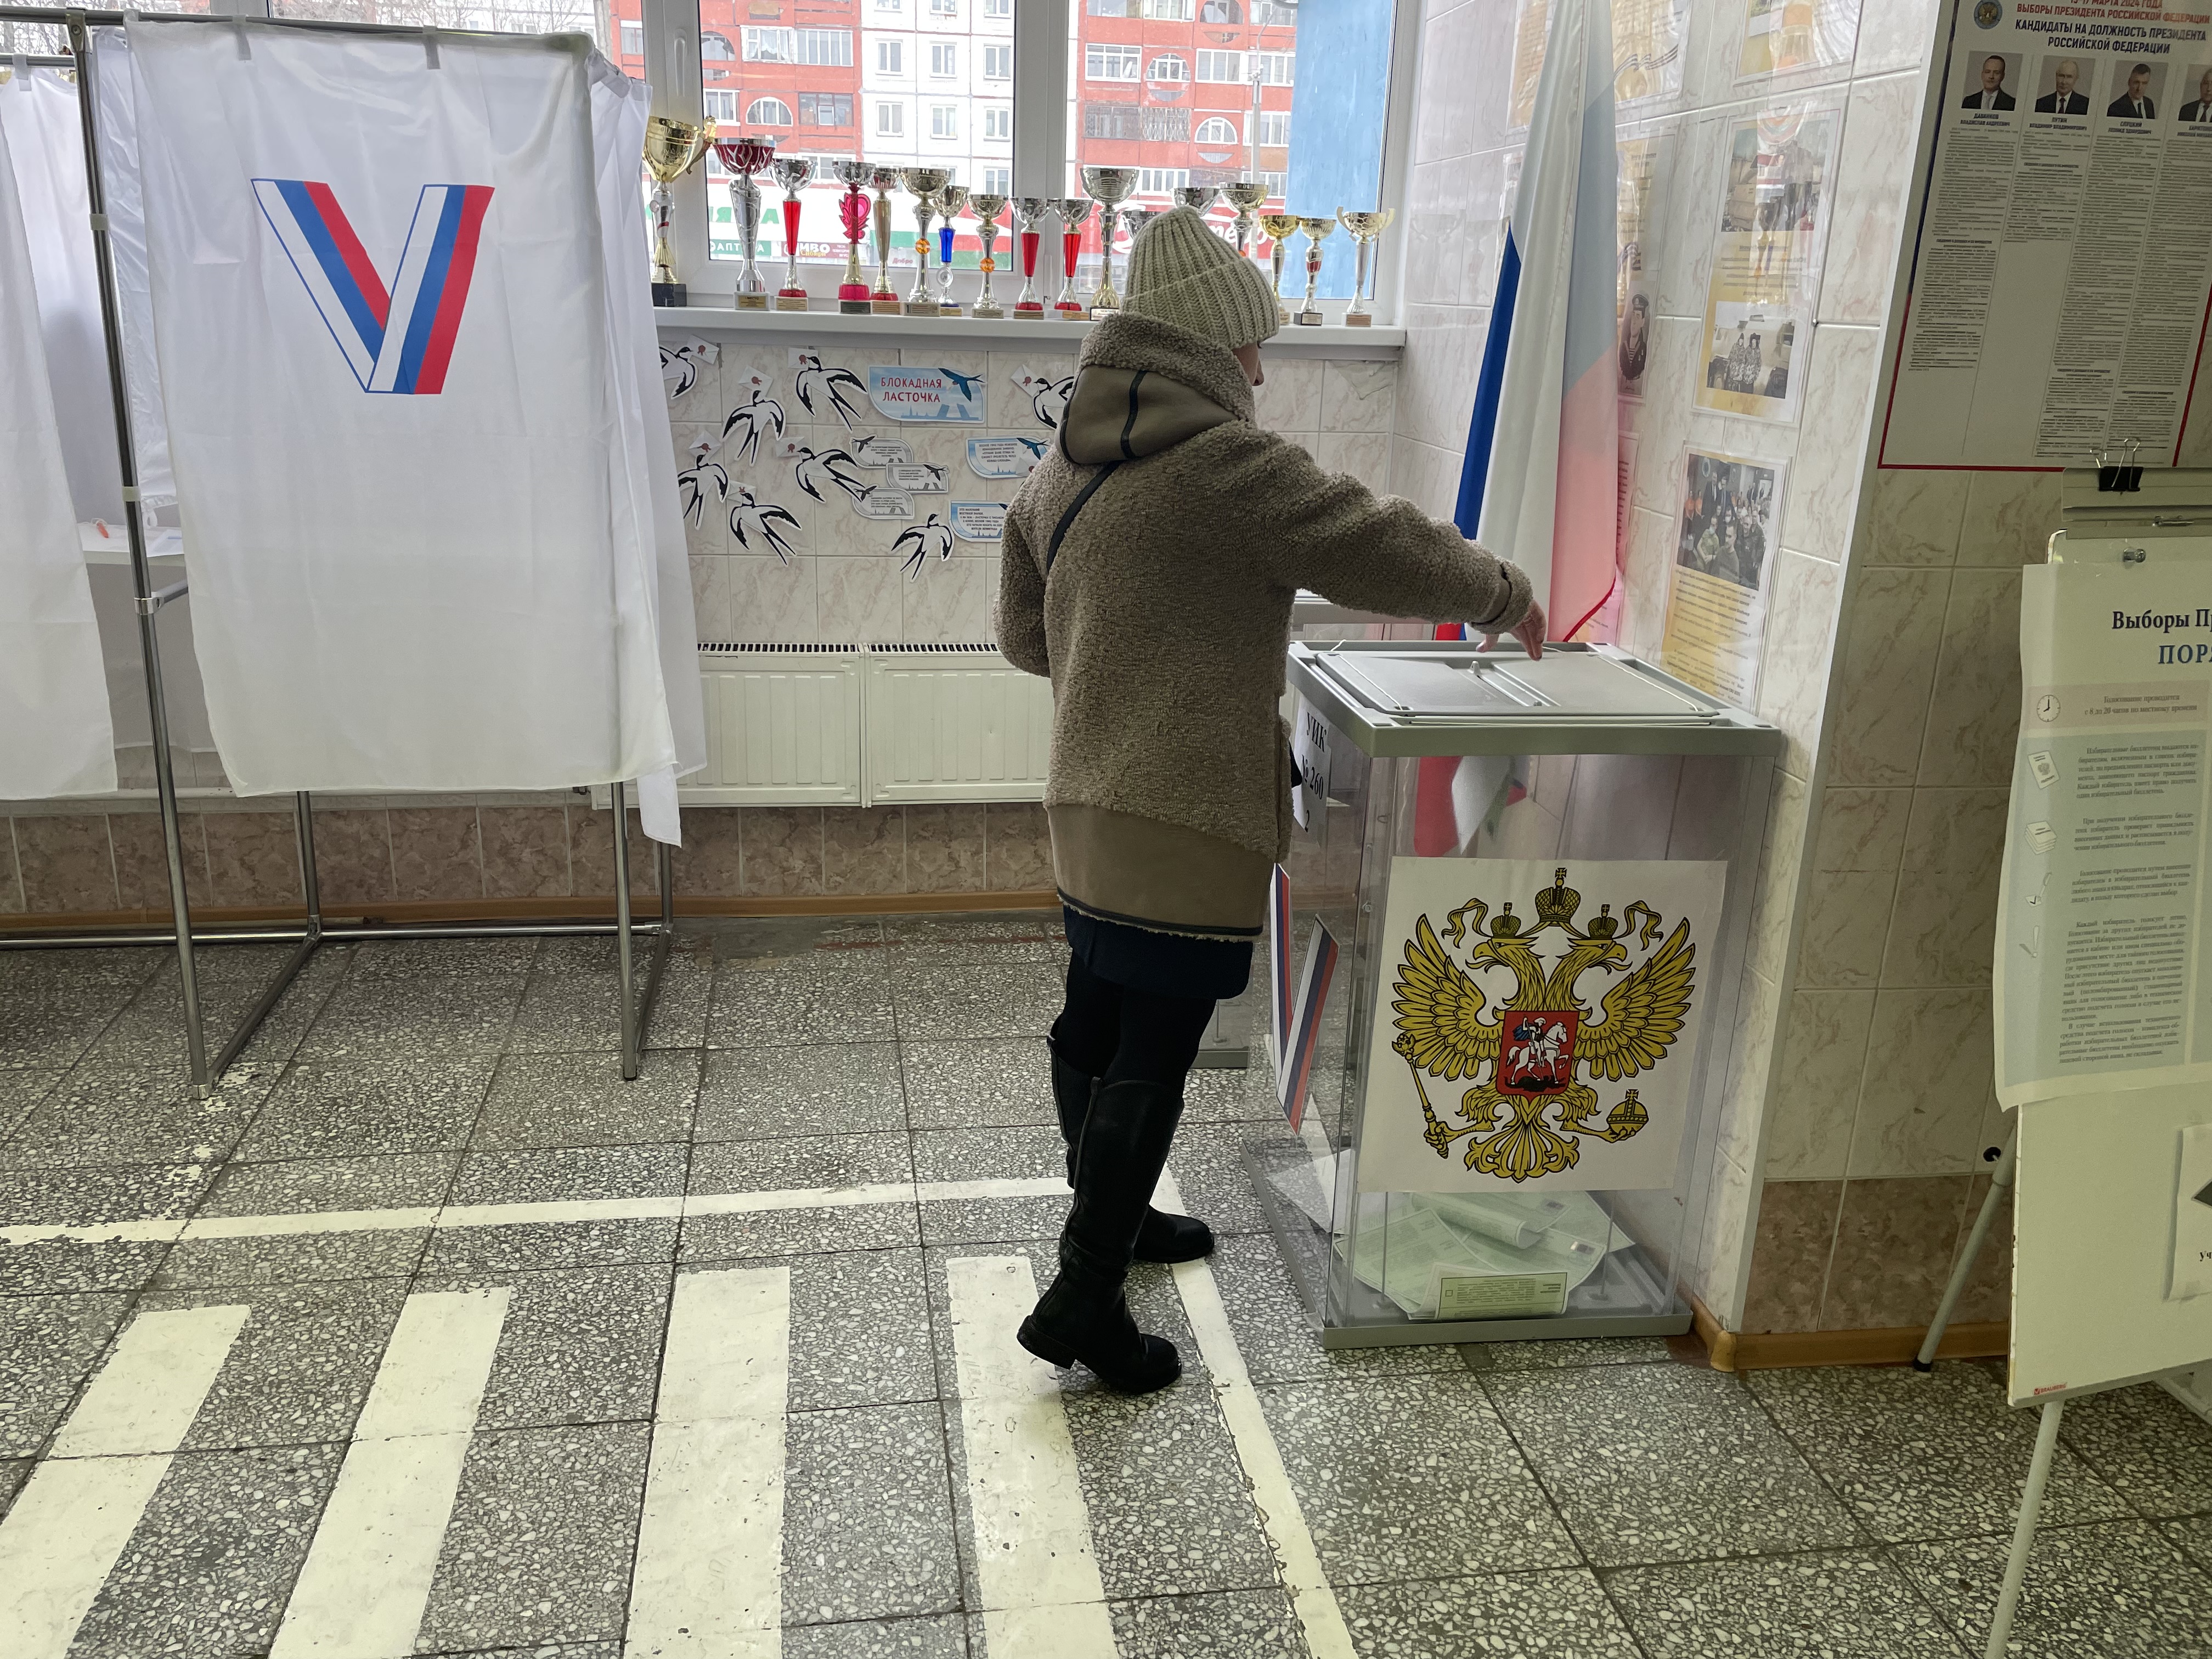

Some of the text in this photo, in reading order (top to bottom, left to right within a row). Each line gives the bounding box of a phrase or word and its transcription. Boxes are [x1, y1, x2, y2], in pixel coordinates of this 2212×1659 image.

[2017, 3, 2210, 24] ВЫБОРЫ ПРЕЗИДЕНТА РОССИЙСКОЙ ФЕДЕРАЦИИ
[2016, 19, 2207, 41] КАНДИДАТЫ НА ДОЛЖНОСТЬ ПРЕЗИДЕНТА
[2048, 36, 2171, 54] РОССИЙСКОЙ ФЕДЕРАЦИИ
[717, 242, 765, 252] АПТА
[881, 377, 941, 388] БЛОКАДНАЯ
[883, 392, 940, 403] ЛАСТОЧКА
[2112, 608, 2212, 634] Выборы П
[2158, 644, 2212, 664] ПОР
[1307, 712, 1327, 752] УИК
[1302, 754, 1324, 800] № 260
[1304, 809, 1310, 833] 2
